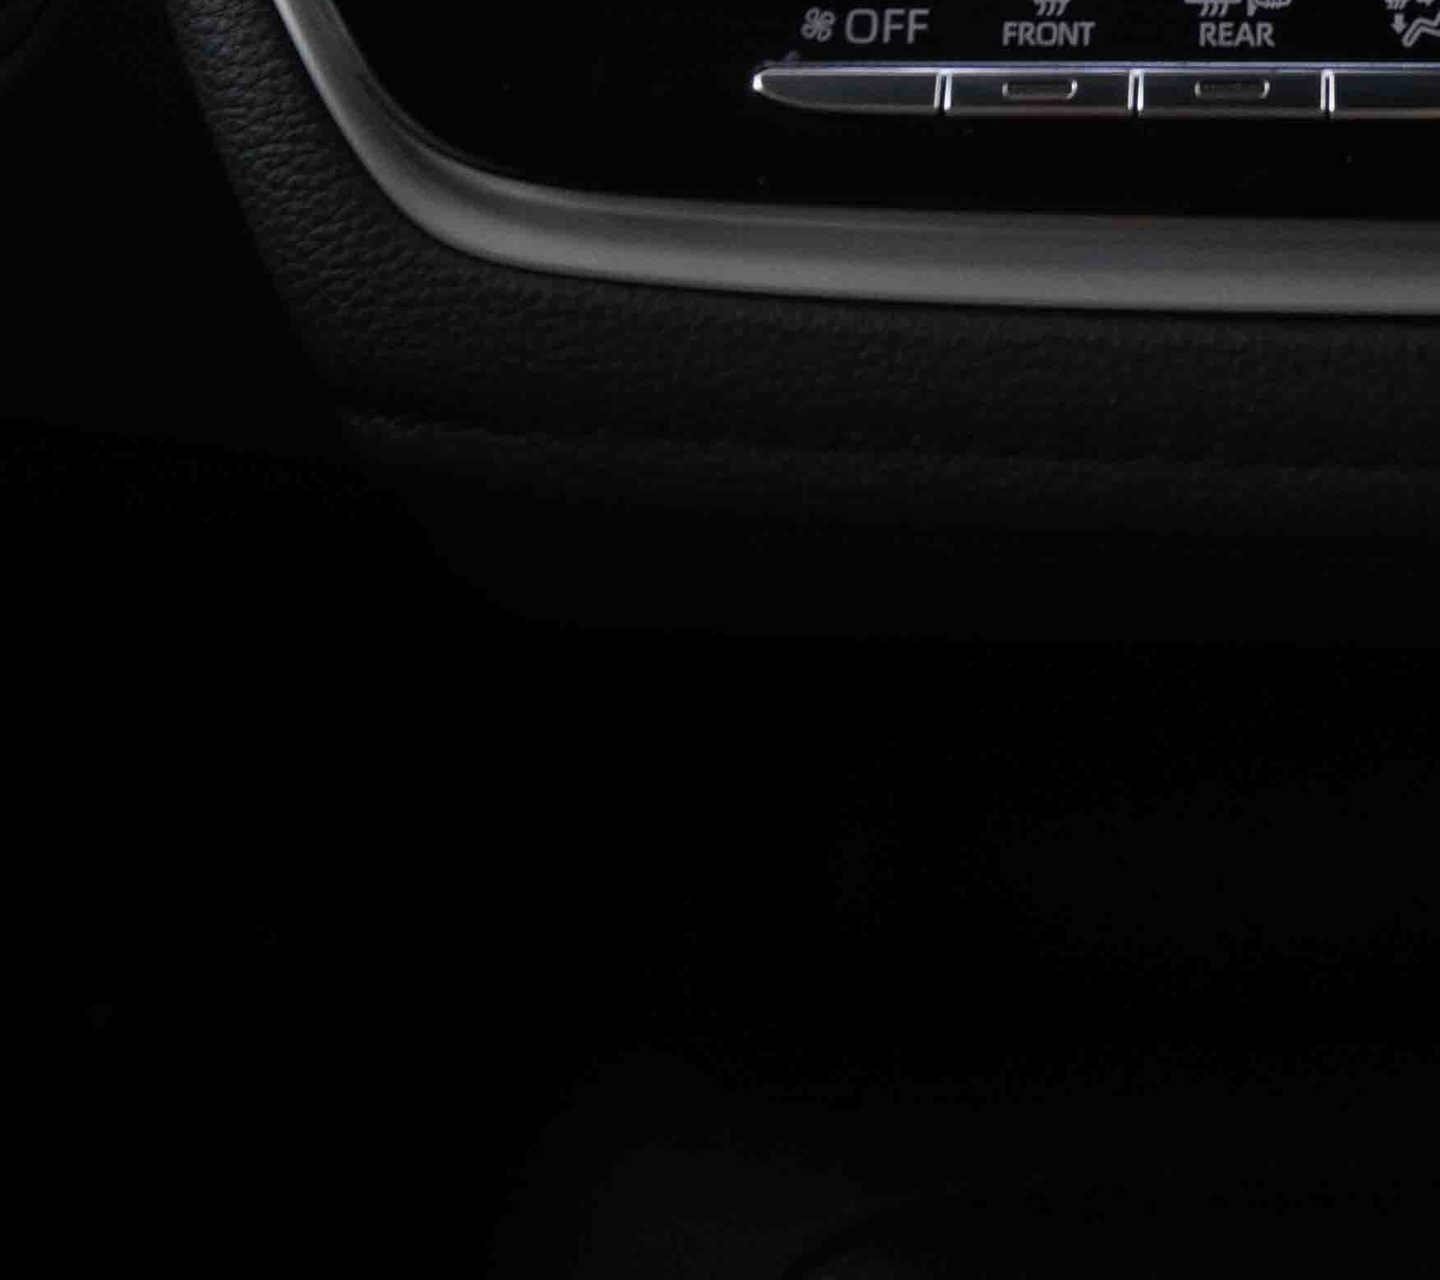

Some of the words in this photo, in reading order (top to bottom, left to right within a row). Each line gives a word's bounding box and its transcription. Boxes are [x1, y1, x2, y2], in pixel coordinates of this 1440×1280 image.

[844, 7, 931, 45] OFF
[1001, 20, 1097, 47] FRONT
[1198, 20, 1276, 48] REAR
